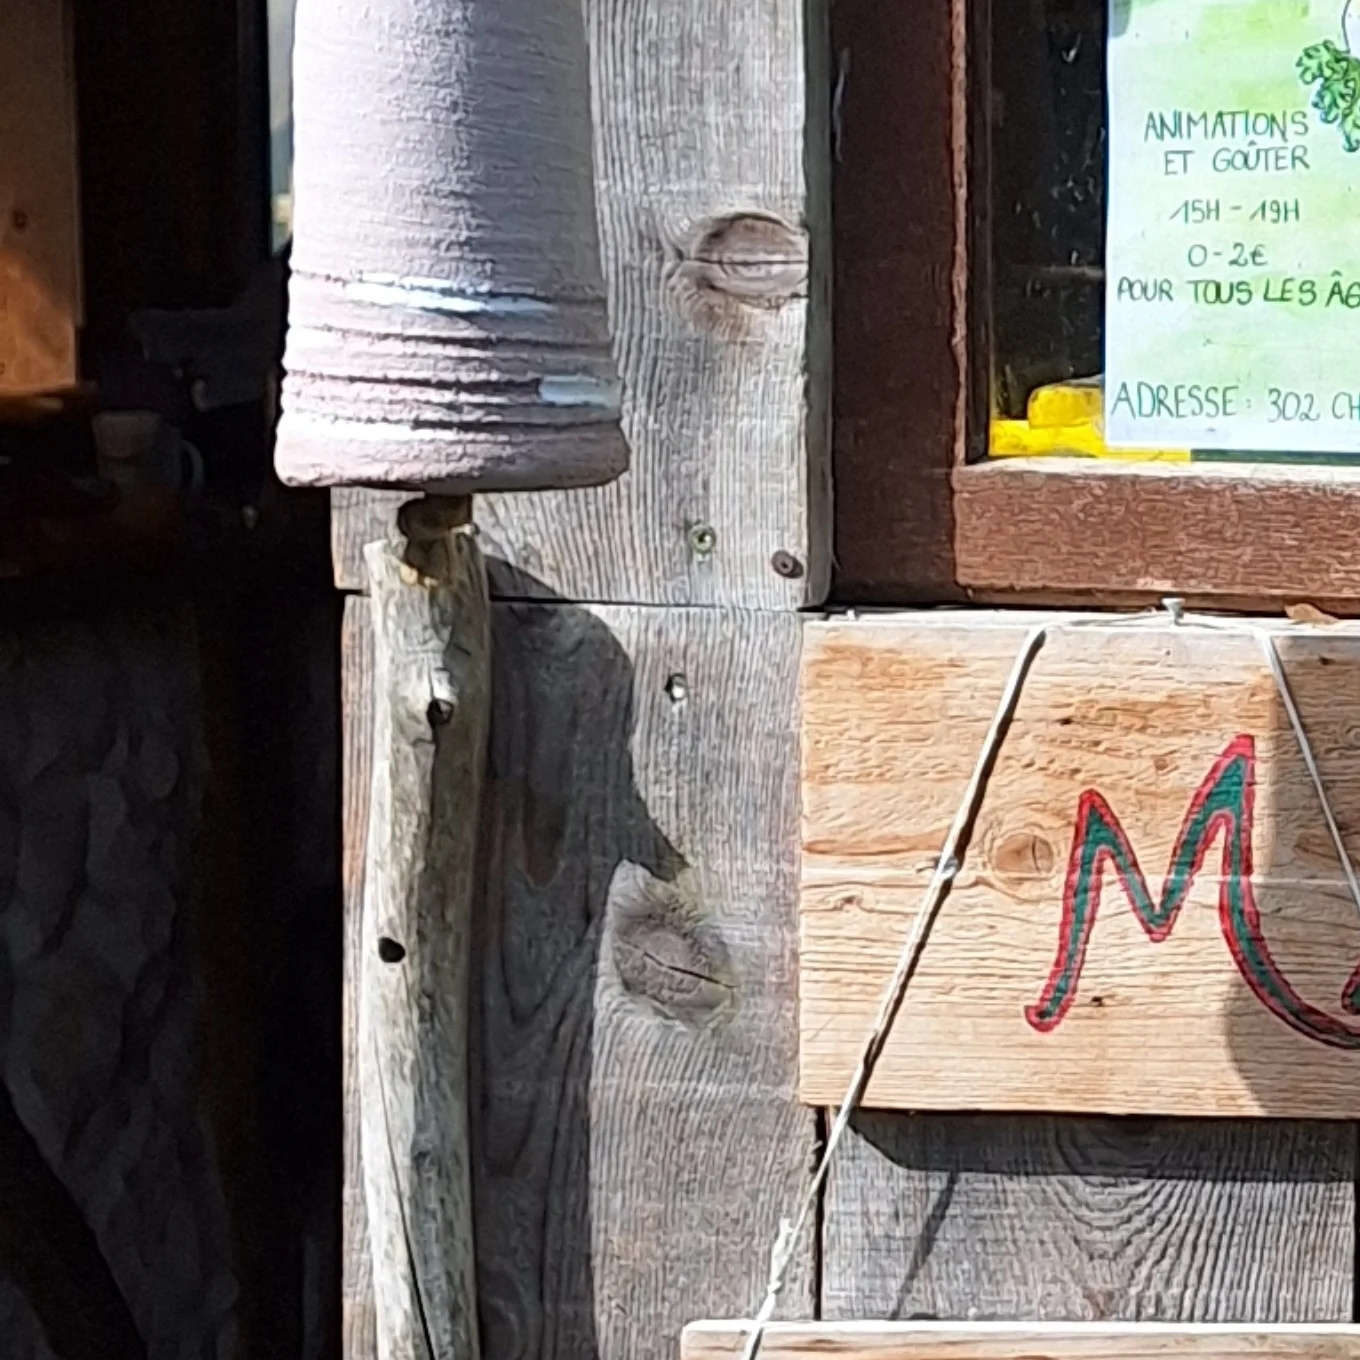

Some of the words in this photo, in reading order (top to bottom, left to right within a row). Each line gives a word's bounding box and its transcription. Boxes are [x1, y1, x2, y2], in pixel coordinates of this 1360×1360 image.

[1144, 109, 1310, 143] ANIMATIONS
[1163, 149, 1195, 176] ET
[1212, 139, 1311, 173] GOÛTER
[1169, 198, 1221, 224] 15H
[1249, 198, 1301, 224] 19H
[1117, 276, 1174, 302] POUR
[1186, 278, 1254, 306] TOUS
[1262, 278, 1318, 306] LES
[1267, 388, 1321, 423] 302
